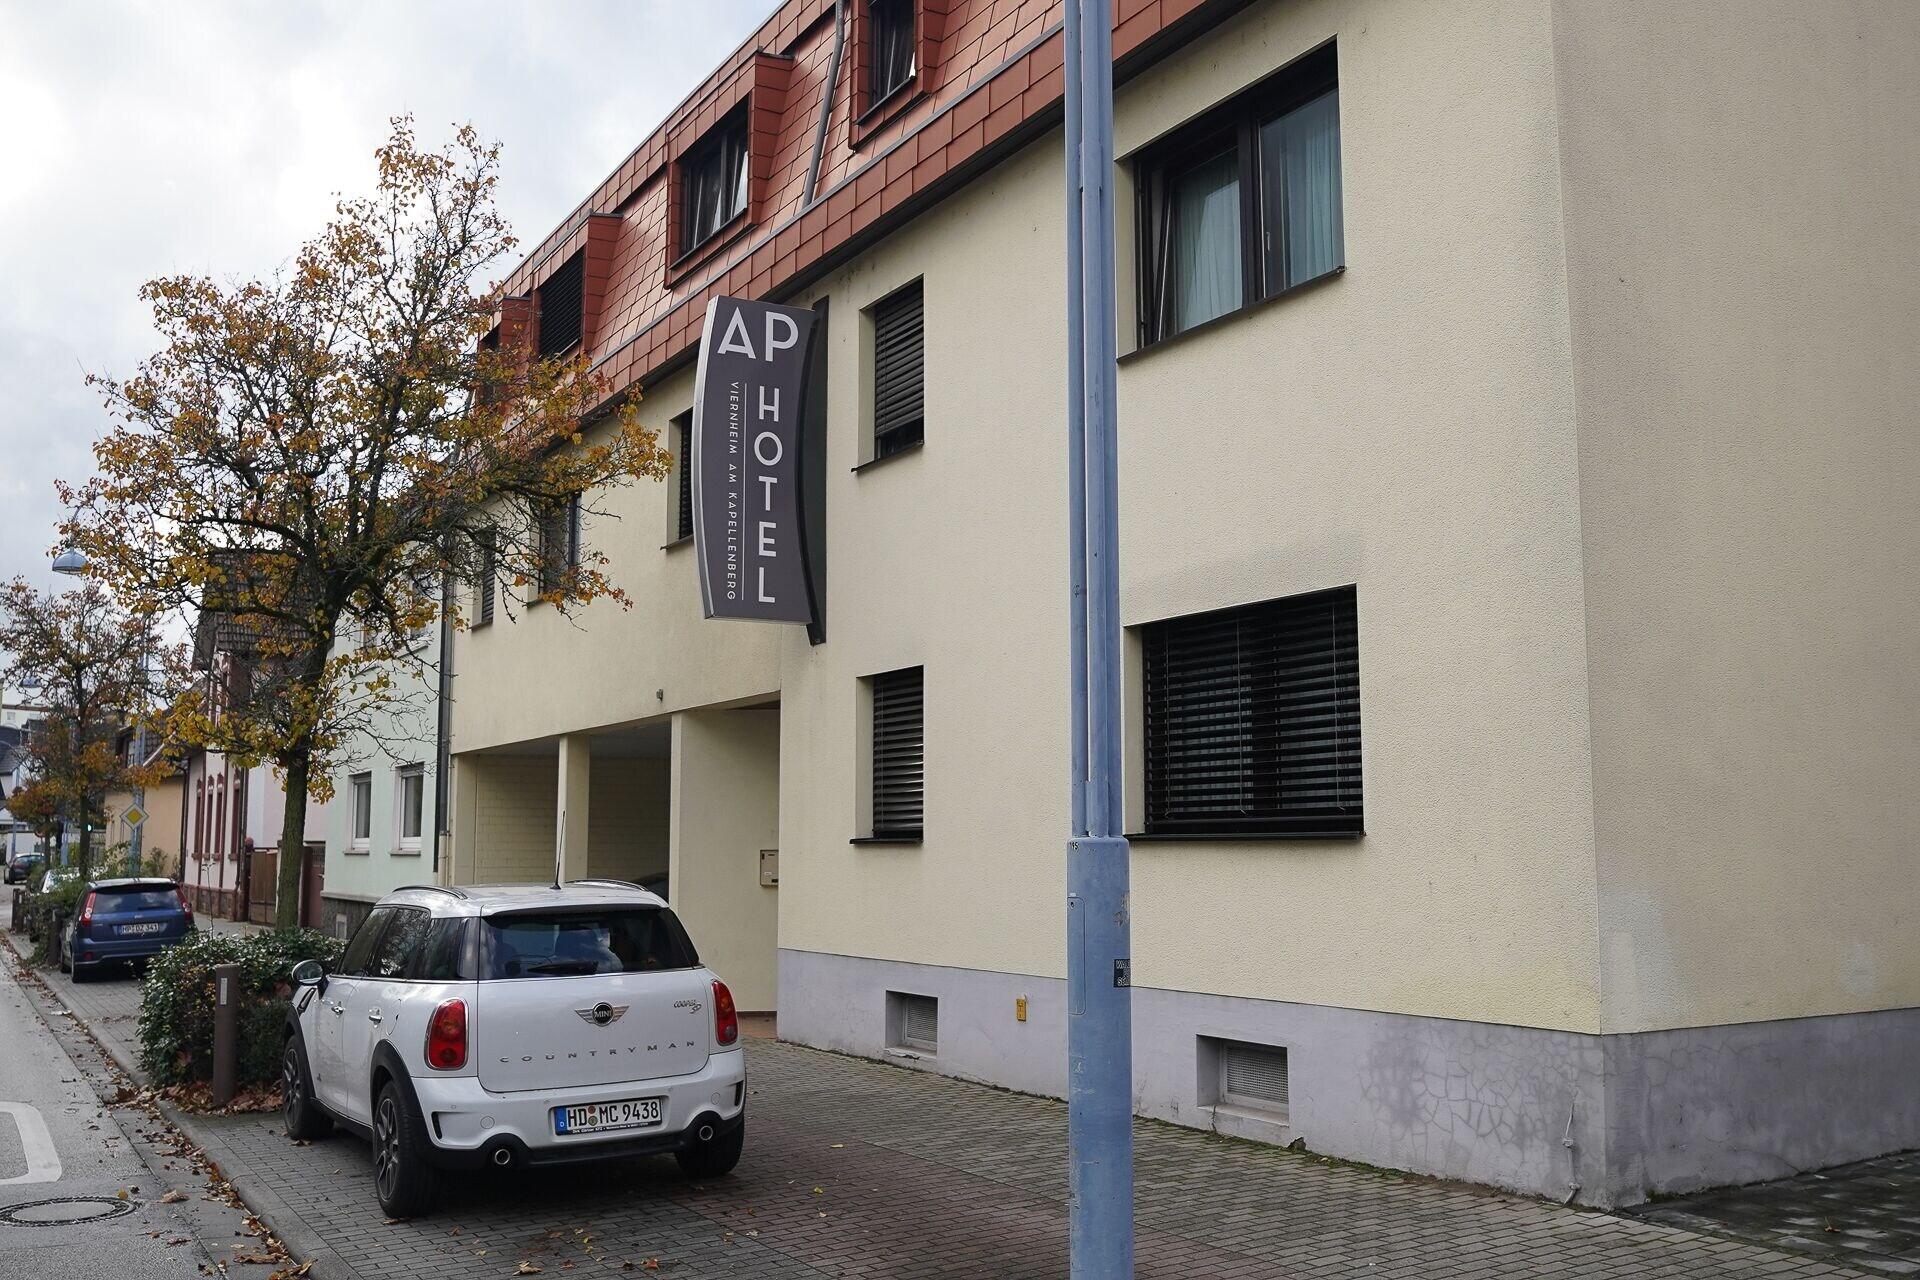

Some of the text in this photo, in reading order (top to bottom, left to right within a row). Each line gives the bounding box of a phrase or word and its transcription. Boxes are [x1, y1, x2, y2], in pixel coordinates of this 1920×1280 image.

[717, 306, 799, 362] AP
[726, 381, 740, 600] VIERNHEIM AM KAPELLENBERG
[753, 385, 783, 603] HOTEL
[594, 1010, 612, 1018] MINI
[499, 1041, 695, 1063] COUNTRYMAN
[567, 1107, 588, 1128] HD
[598, 1105, 619, 1124] MC
[622, 1101, 660, 1122] 9438
